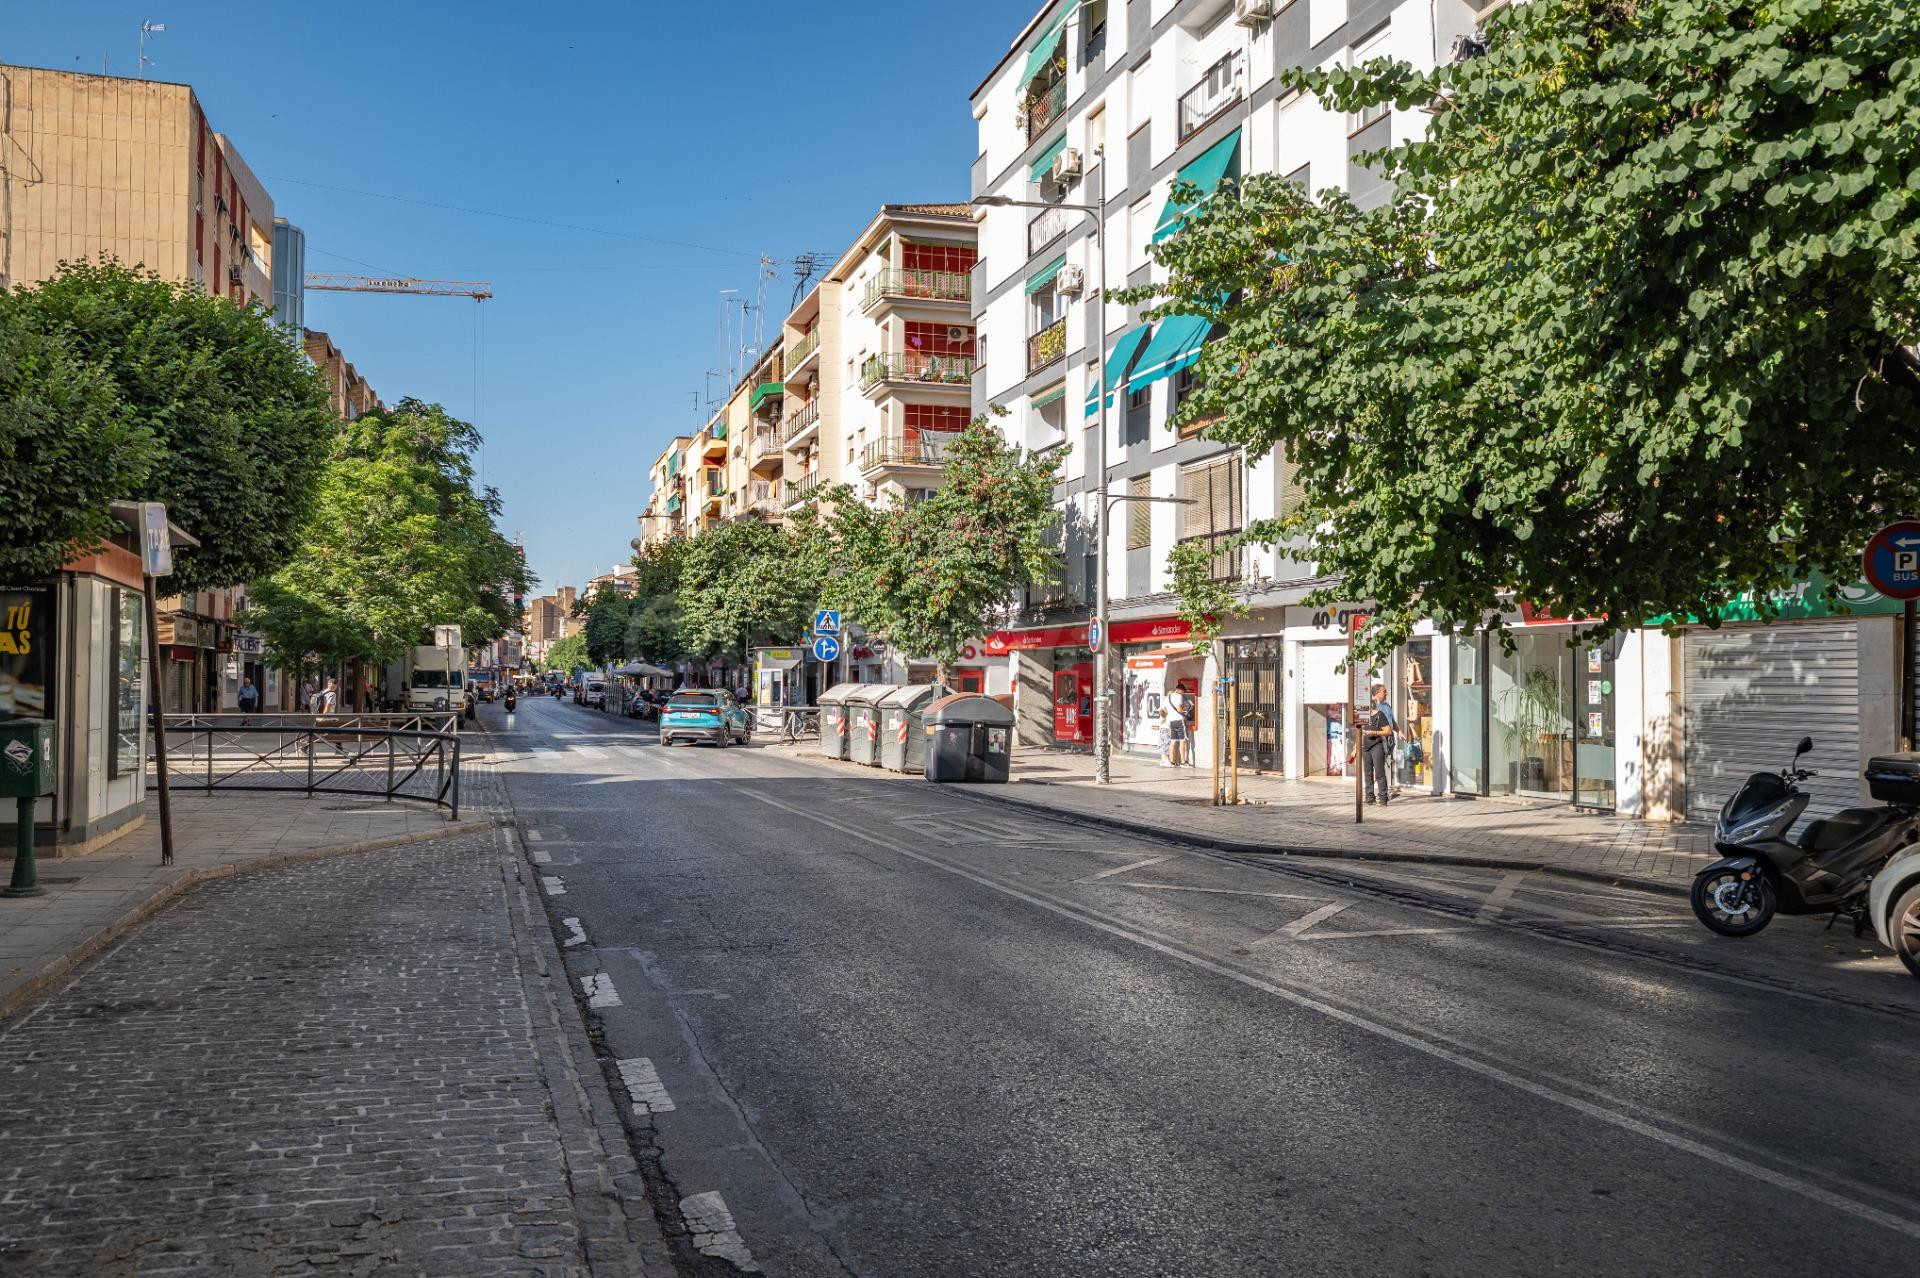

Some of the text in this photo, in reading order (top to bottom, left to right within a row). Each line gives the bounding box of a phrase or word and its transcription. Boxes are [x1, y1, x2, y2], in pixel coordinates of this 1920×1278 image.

[1900, 553, 1913, 569] P
[1893, 571, 1919, 581] BUS
[8, 601, 31, 630] TÚ
[1312, 611, 1330, 630] 40
[1157, 624, 1181, 635] Santander
